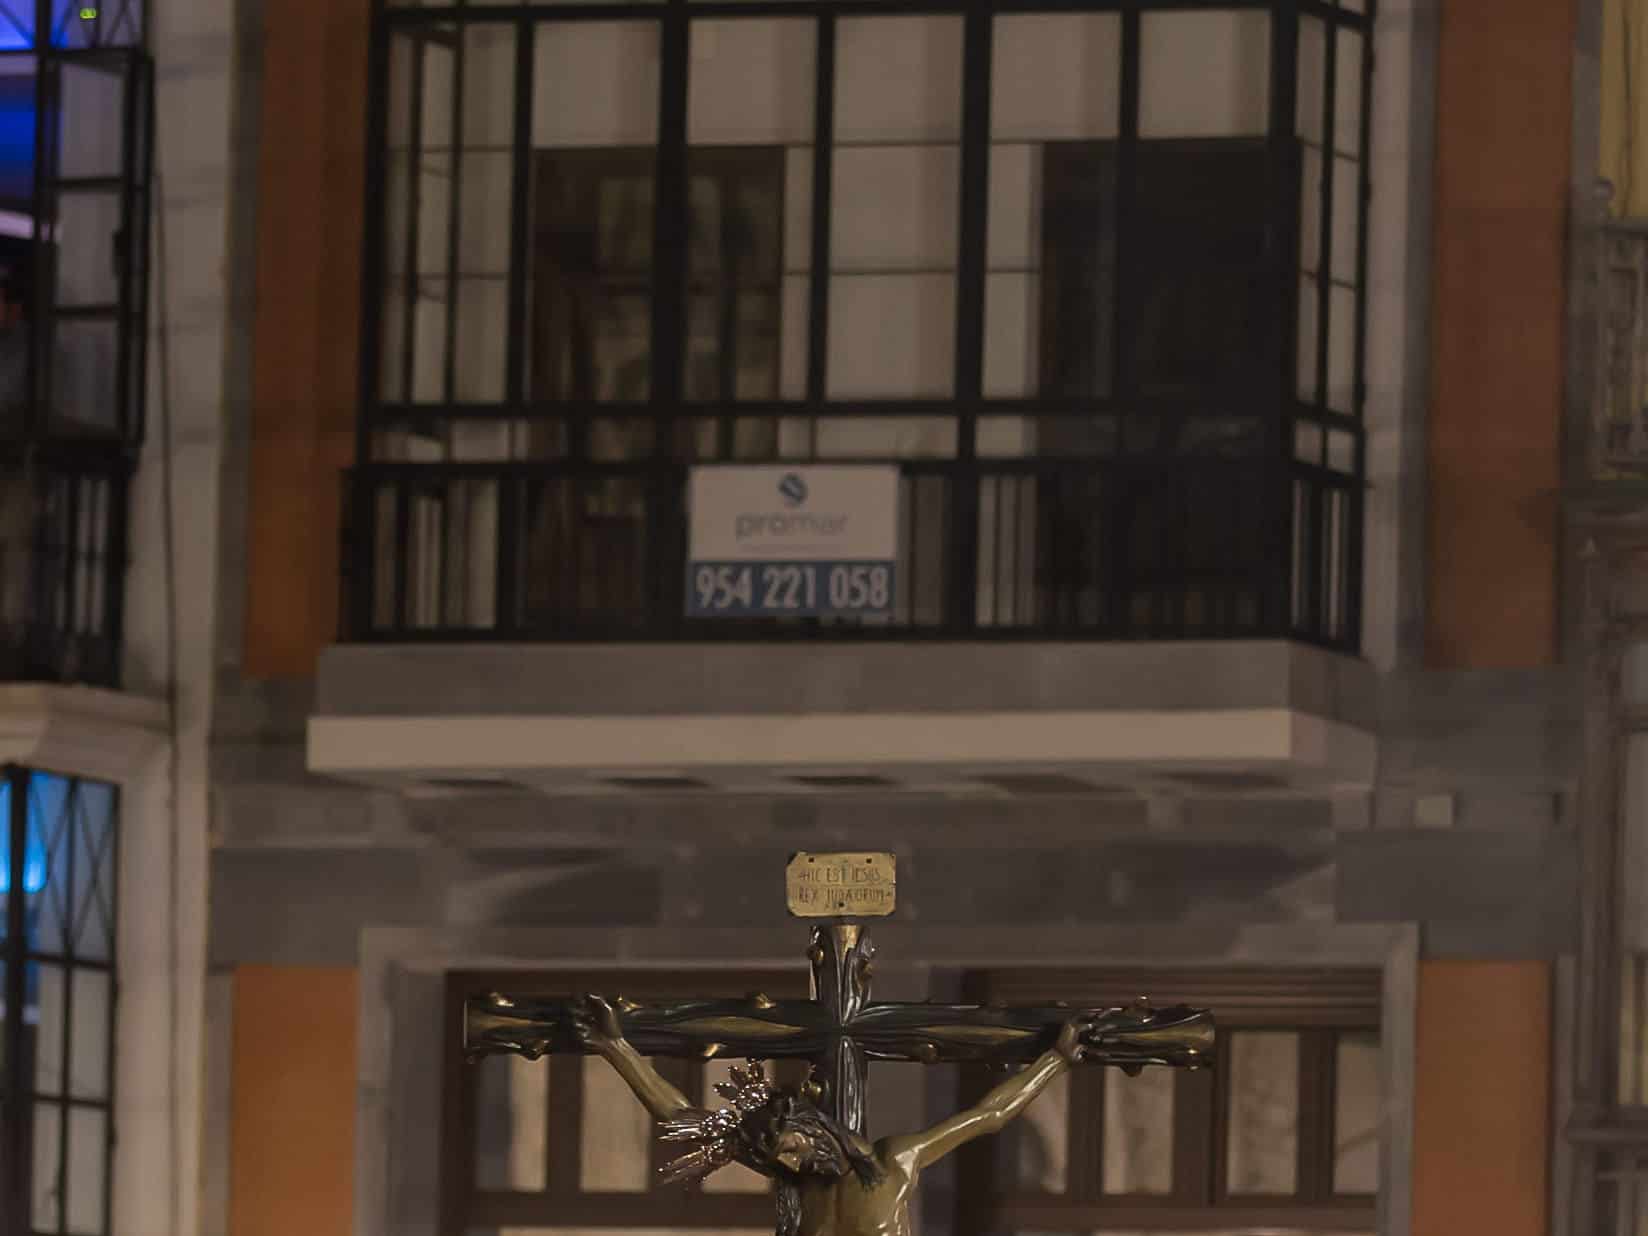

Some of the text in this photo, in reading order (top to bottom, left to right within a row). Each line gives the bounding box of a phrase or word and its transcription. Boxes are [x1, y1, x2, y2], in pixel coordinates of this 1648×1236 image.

[696, 565, 889, 608] 954 221 058
